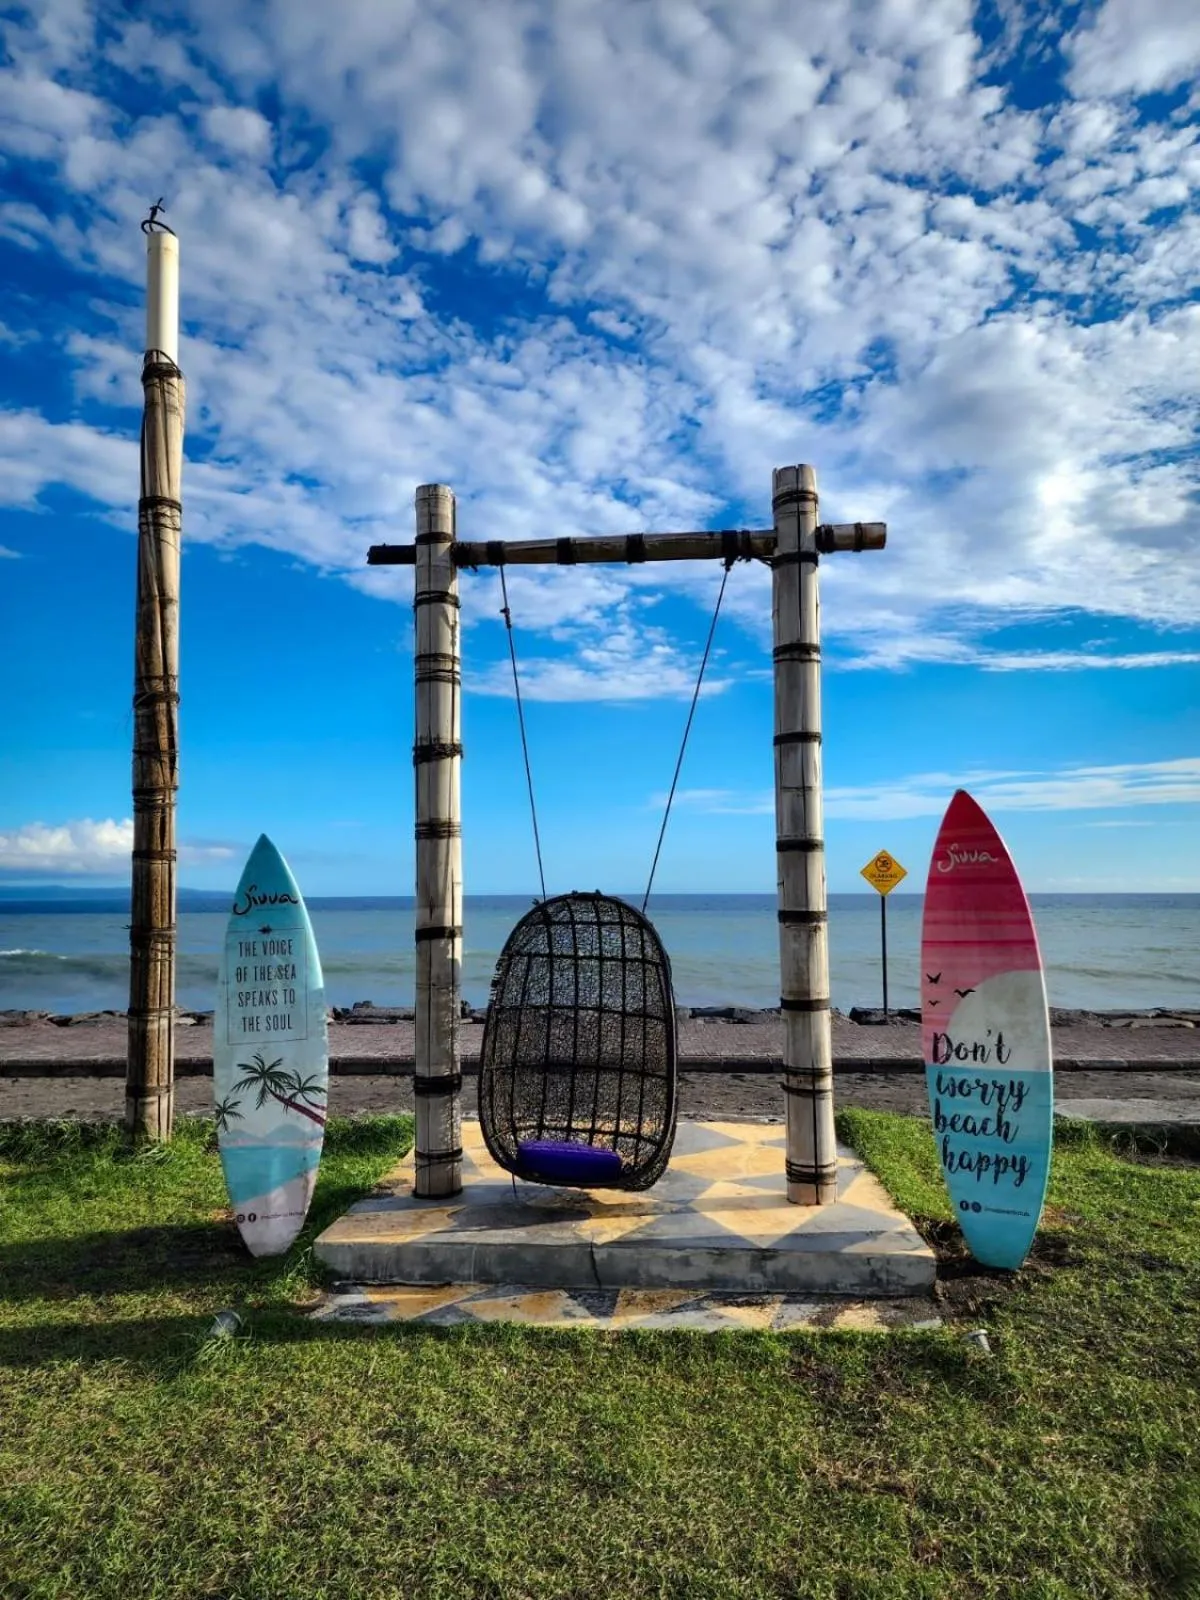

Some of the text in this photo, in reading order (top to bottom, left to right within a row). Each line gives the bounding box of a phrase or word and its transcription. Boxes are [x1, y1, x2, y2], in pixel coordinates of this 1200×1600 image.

[239, 939, 293, 957] THE VOICE
[236, 964, 296, 983] OF THE SEA
[238, 988, 296, 1007] SPEAKS TO
[242, 1014, 293, 1032] THE SOUL
[932, 1029, 1011, 1065] Don't
[936, 1071, 1030, 1113] worry
[935, 1098, 1019, 1144] beach
[942, 1134, 1032, 1188] happy
